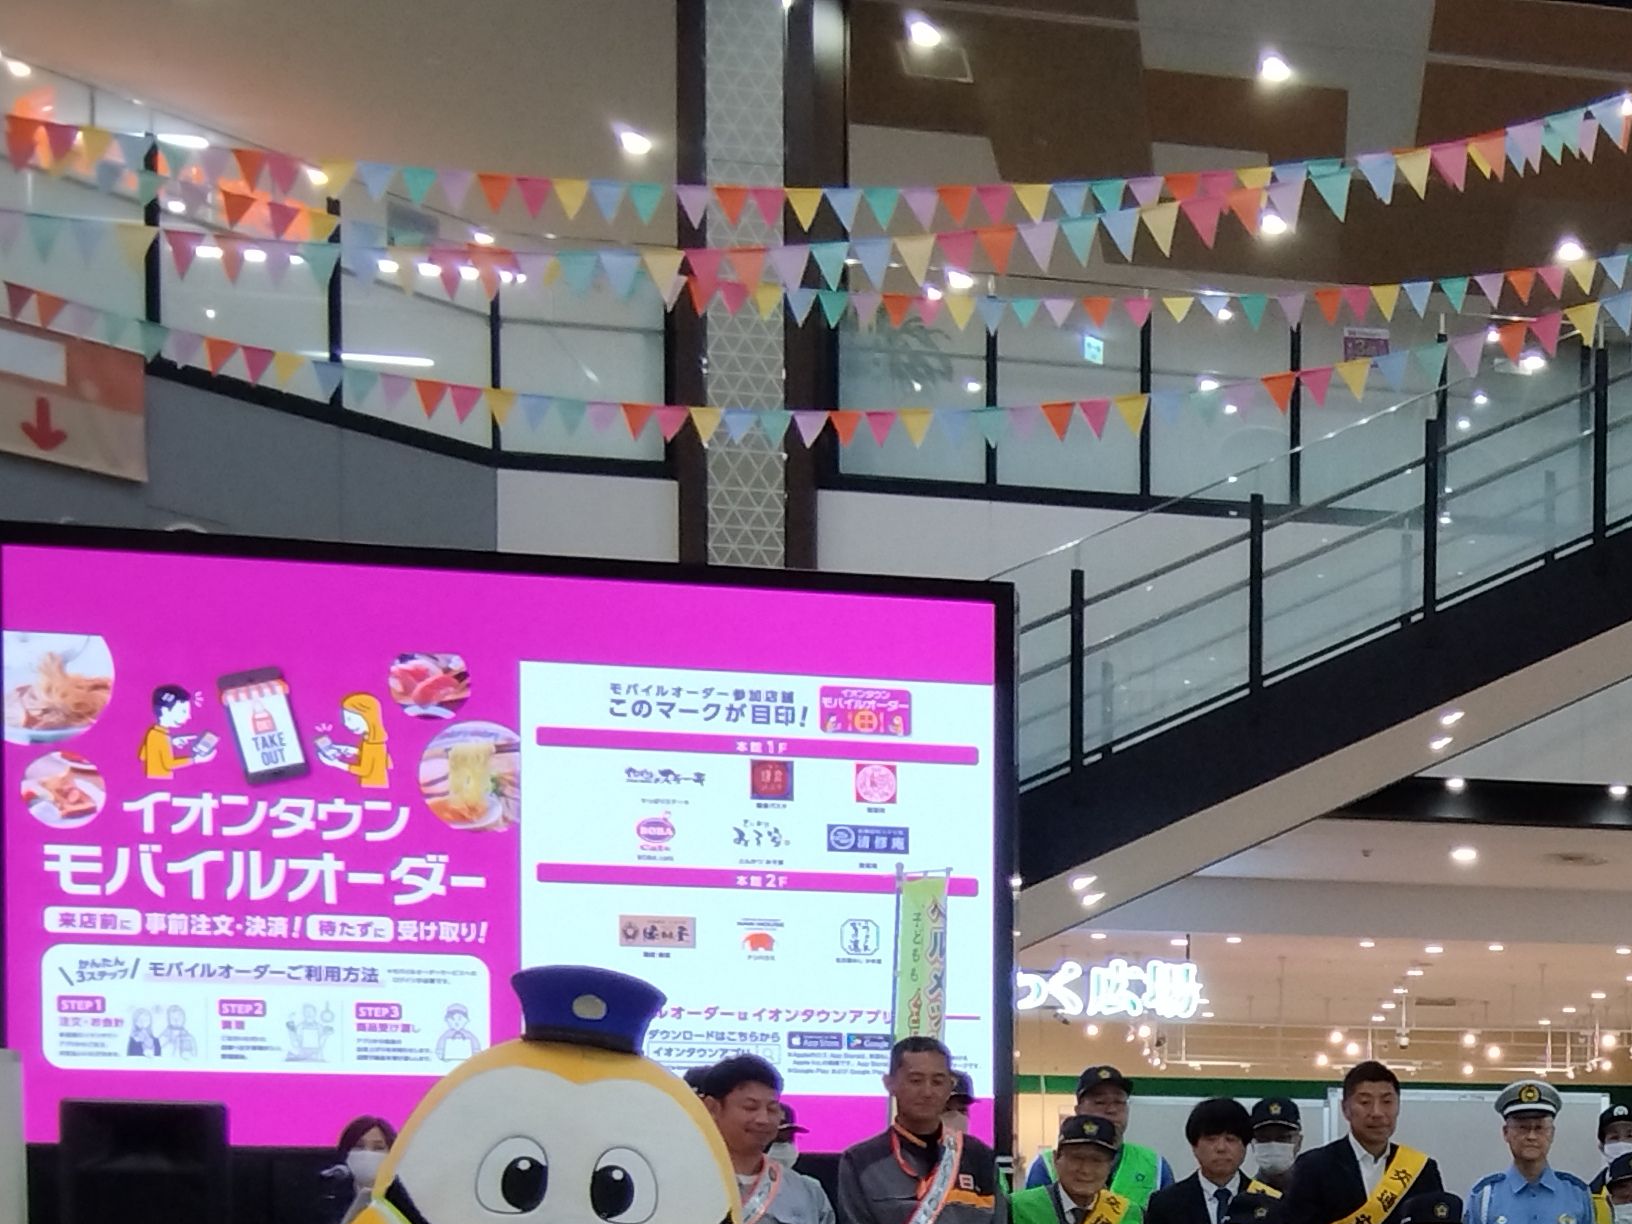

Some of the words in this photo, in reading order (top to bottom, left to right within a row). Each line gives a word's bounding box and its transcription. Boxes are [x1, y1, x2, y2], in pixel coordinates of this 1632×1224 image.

[609, 683, 795, 704] モバイルオーダー参加店舗
[252, 731, 287, 751] TAKE
[261, 748, 286, 766] OUT
[123, 793, 410, 842] イオンタウン
[43, 844, 486, 906] モバイルオーダー
[58, 912, 132, 931] 来店前に
[318, 920, 386, 939] 待たずに
[78, 957, 126, 969] かんたん
[149, 961, 380, 984] モバイルオーダーご利用方法
[927, 902, 946, 1037] ヘルメッ
[76, 968, 130, 983] 3ステップ
[648, 1029, 781, 1043] ダウンロードはこちらから
